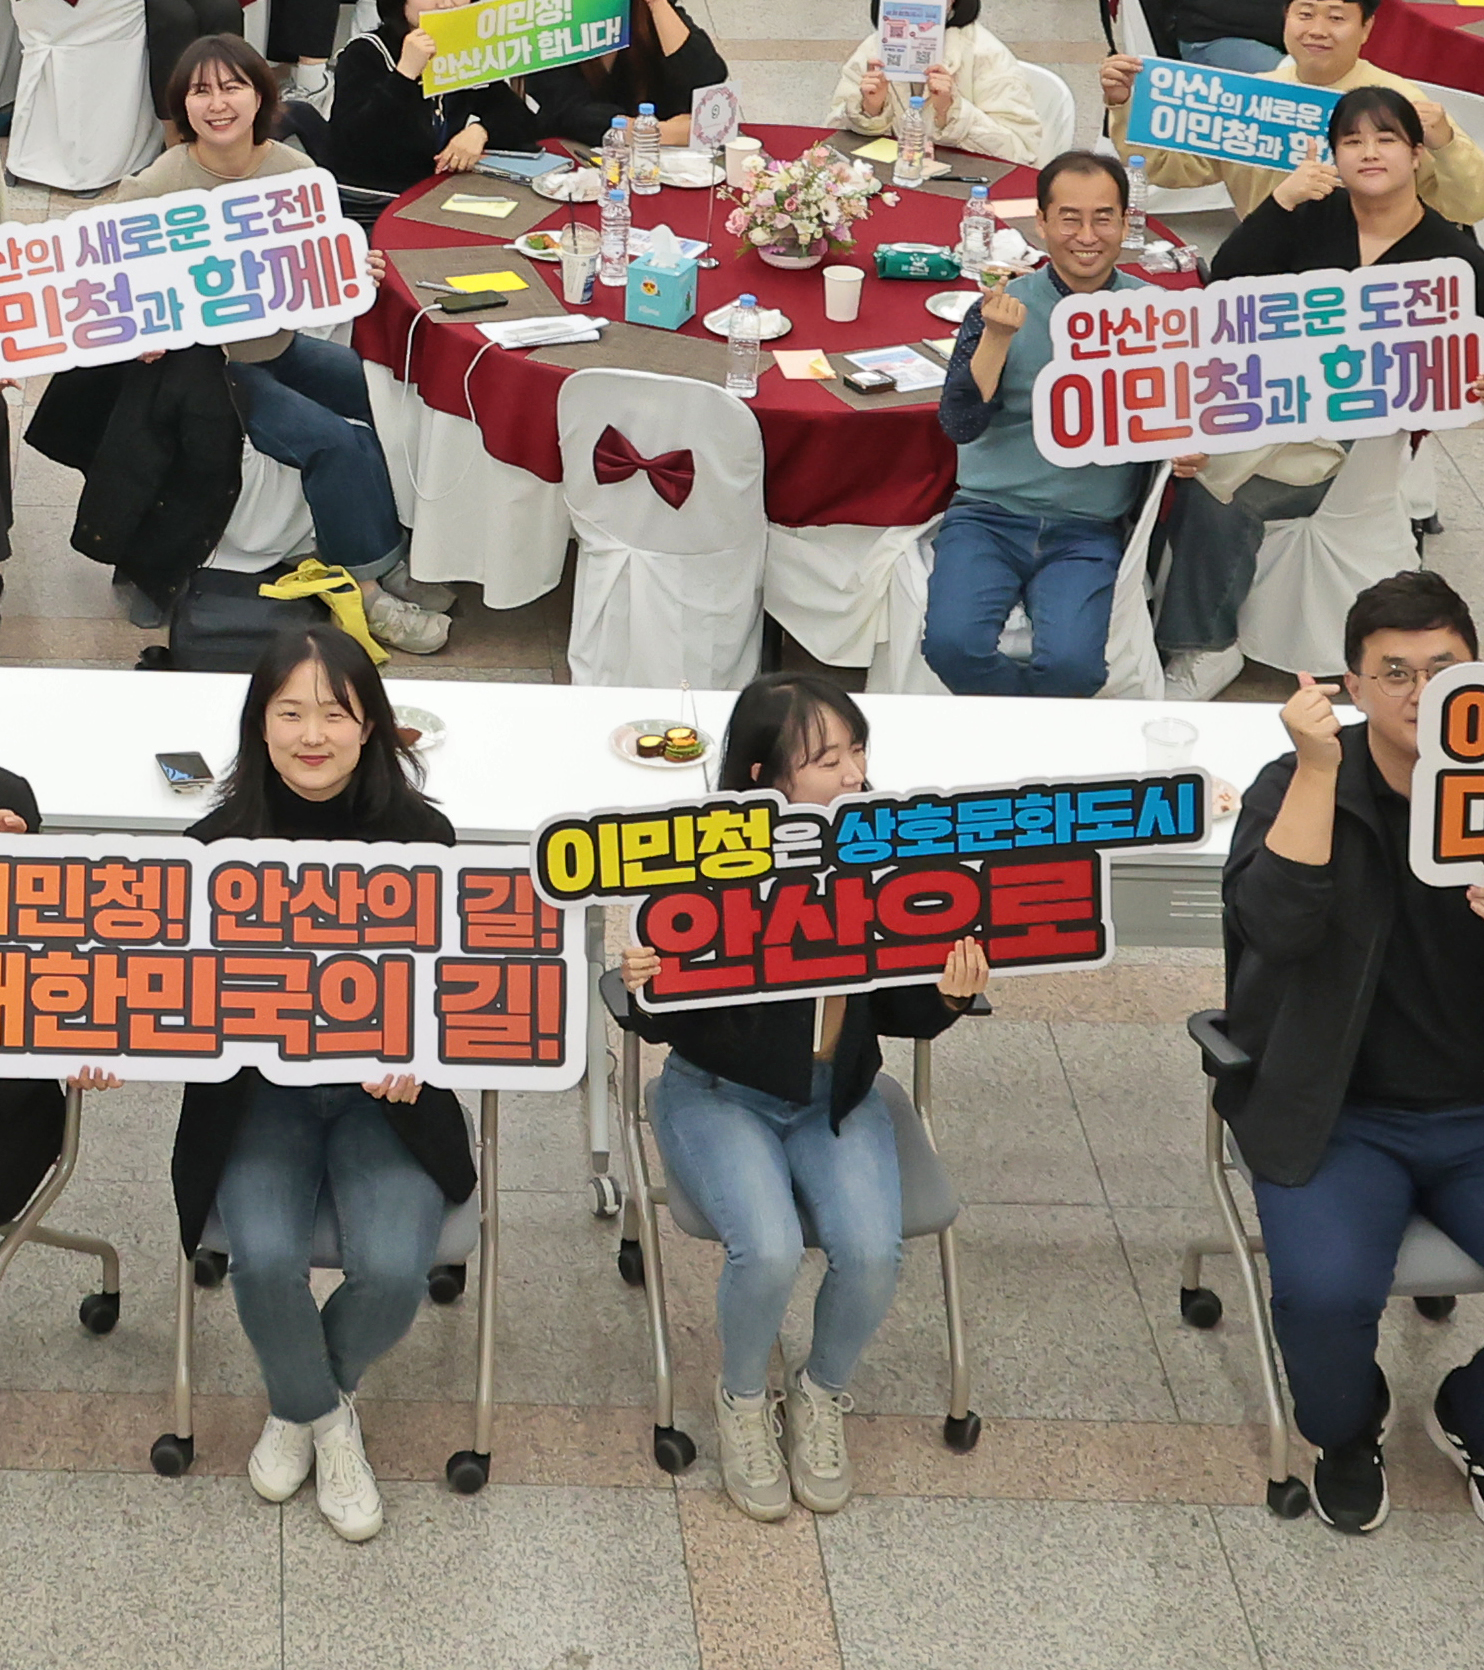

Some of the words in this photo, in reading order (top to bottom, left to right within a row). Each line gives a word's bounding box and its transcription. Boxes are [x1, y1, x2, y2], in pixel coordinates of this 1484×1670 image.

[432, 36, 533, 85] 안산시가
[537, 16, 622, 60] 합니다!
[75, 203, 212, 269] 새로운
[221, 182, 327, 243] 도전!
[188, 232, 361, 328] 함께!
[1067, 304, 1200, 361] 안산의
[1211, 286, 1346, 346] 새로운
[1358, 274, 1460, 331] 도전!
[1048, 353, 1312, 449] 이민청과
[1319, 331, 1481, 423] 함께!
[546, 806, 823, 893] 이민청은
[836, 783, 1197, 865] 상호문화도시
[213, 866, 440, 948] 안산의
[645, 859, 1099, 996] 안산으로
[438, 962, 561, 1062] 길!
